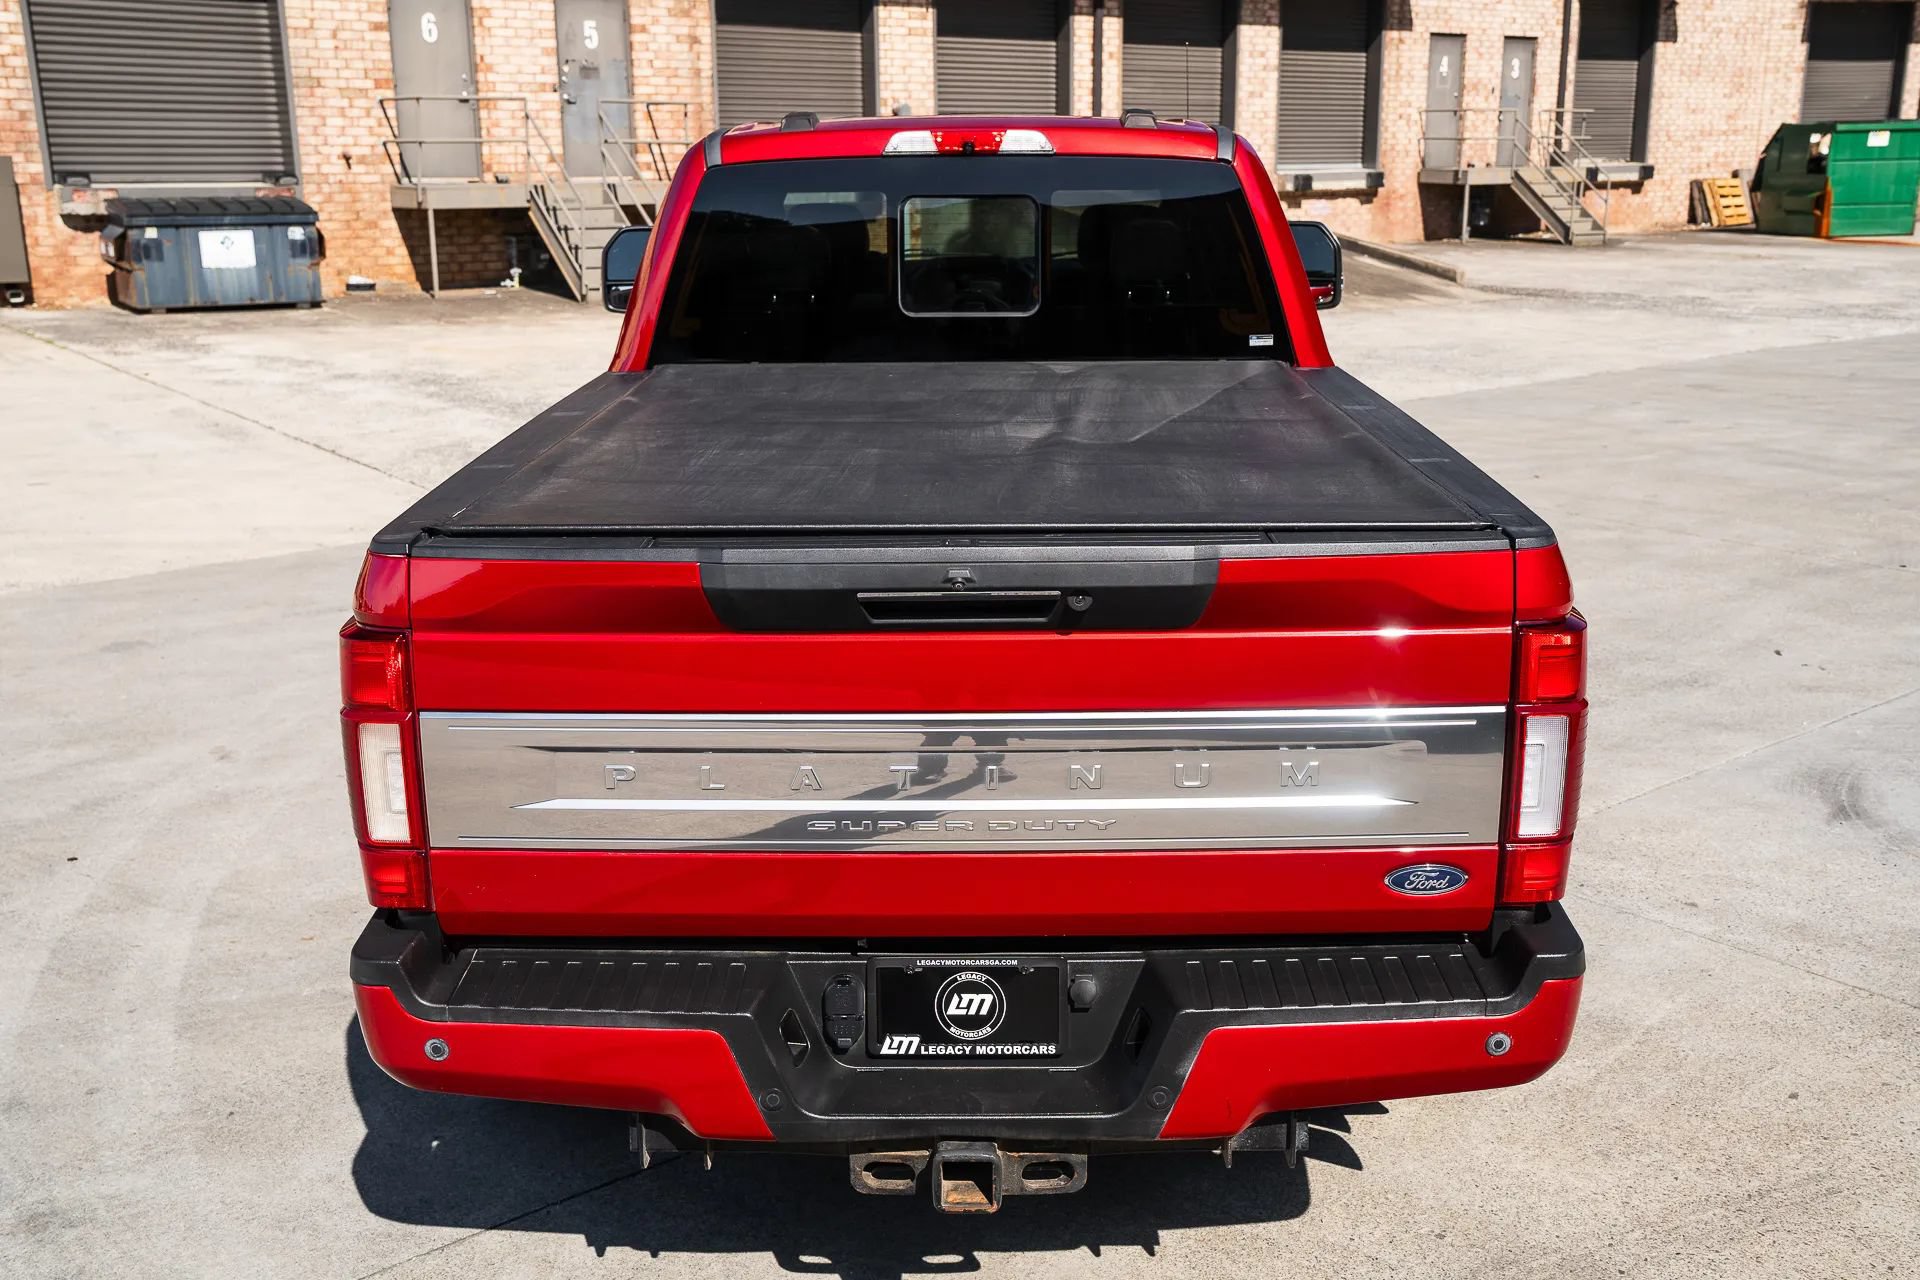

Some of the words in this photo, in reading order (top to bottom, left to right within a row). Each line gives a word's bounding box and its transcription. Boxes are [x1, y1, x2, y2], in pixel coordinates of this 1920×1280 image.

[420, 11, 439, 43] 6
[582, 19, 600, 49] 5
[1439, 55, 1448, 76] 4
[1511, 57, 1520, 79] 3
[603, 761, 1320, 791] PLATINUM
[807, 820, 974, 832] SUPER
[988, 819, 1117, 831] DUTY
[1404, 871, 1450, 889] Ford
[956, 973, 988, 982] LEGACY
[949, 1026, 992, 1038] MOTORCARS
[920, 1045, 972, 1055] LEGACY
[975, 1045, 1056, 1055] MOTORCARS
